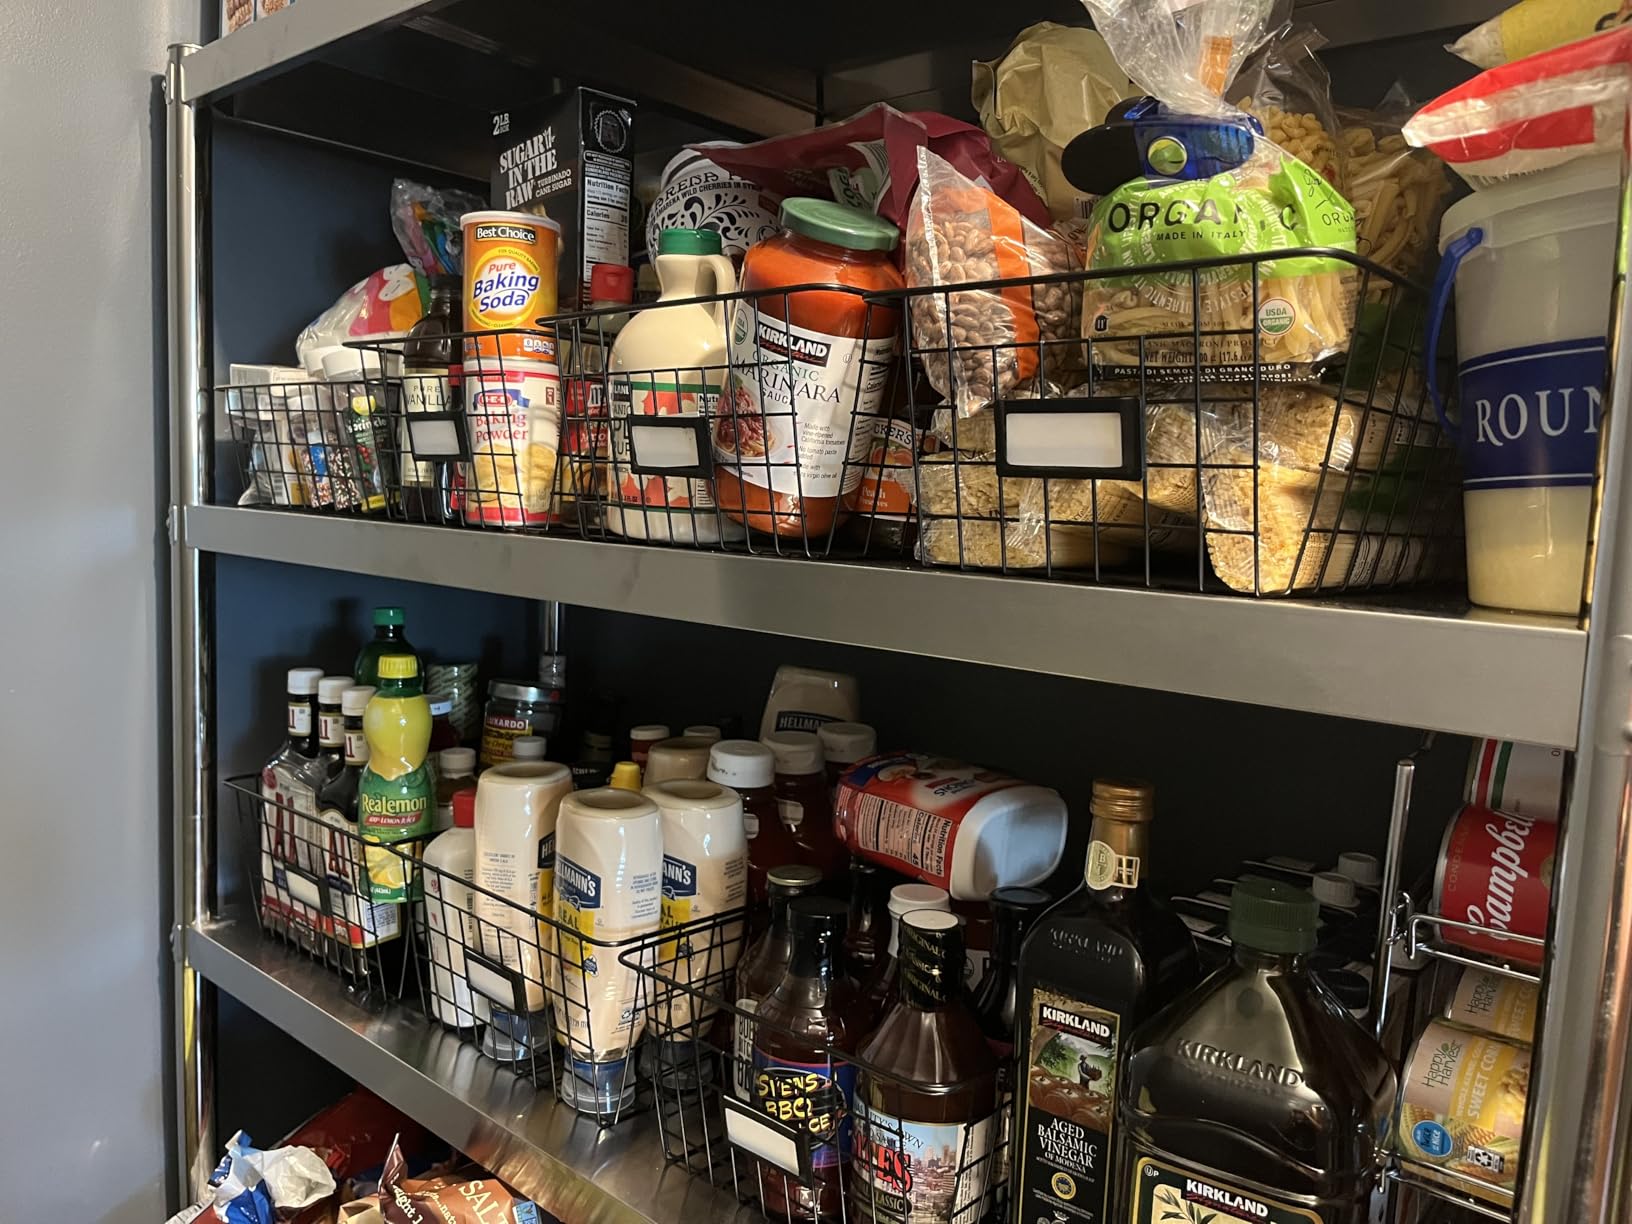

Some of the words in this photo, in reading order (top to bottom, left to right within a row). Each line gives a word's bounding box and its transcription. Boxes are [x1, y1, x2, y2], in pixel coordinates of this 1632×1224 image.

[492, 115, 501, 136] 2
[499, 134, 546, 175] SUGAR
[507, 161, 523, 190] IN
[524, 150, 558, 180] THE
[536, 168, 572, 188] TURBINADO
[505, 179, 535, 211] RAW
[534, 184, 551, 198] CANE
[551, 178, 573, 194] SUGAR
[681, 186, 698, 200] WILD
[699, 180, 733, 192] CHERRIES
[476, 226, 497, 239] Best
[497, 226, 535, 241] Choice
[1156, 230, 1187, 241] MADE
[1192, 230, 1204, 239] IN
[1210, 229, 1246, 239] ITALY
[488, 261, 517, 274] Pure
[472, 270, 540, 300] Baking
[479, 290, 526, 313] Soda
[1264, 308, 1288, 317] USDA
[1261, 318, 1291, 327] ORGANIC
[758, 323, 829, 359] KIRKLAND
[1159, 367, 1202, 375] SEMOL
[1203, 366, 1216, 375] DI
[1259, 362, 1291, 373] DURO
[1160, 350, 1193, 364] WEIGHT
[475, 429, 529, 446] Powder
[779, 715, 826, 730] HELLMA
[361, 793, 428, 817] ReaLemon
[936, 819, 951, 851] Nutrition
[931, 853, 944, 876] Facts
[1042, 1005, 1110, 1038] KIRKLAND
[1178, 1039, 1303, 1087] KIRKLAND
[1420, 1046, 1445, 1088] Happy
[1436, 1040, 1463, 1086] Harvest
[1467, 1074, 1490, 1119] SWEET
[765, 1097, 814, 1121] BBQ
[1051, 1117, 1085, 1140] AGED
[1037, 1123, 1098, 1158] BALSAMIC
[1040, 1136, 1094, 1169] VINEGAR
[1044, 1151, 1054, 1160] OF
[1055, 1156, 1087, 1174] MODENA
[873, 1190, 906, 1212] LASSIC
[1185, 1179, 1269, 1217] KIRKLAND
